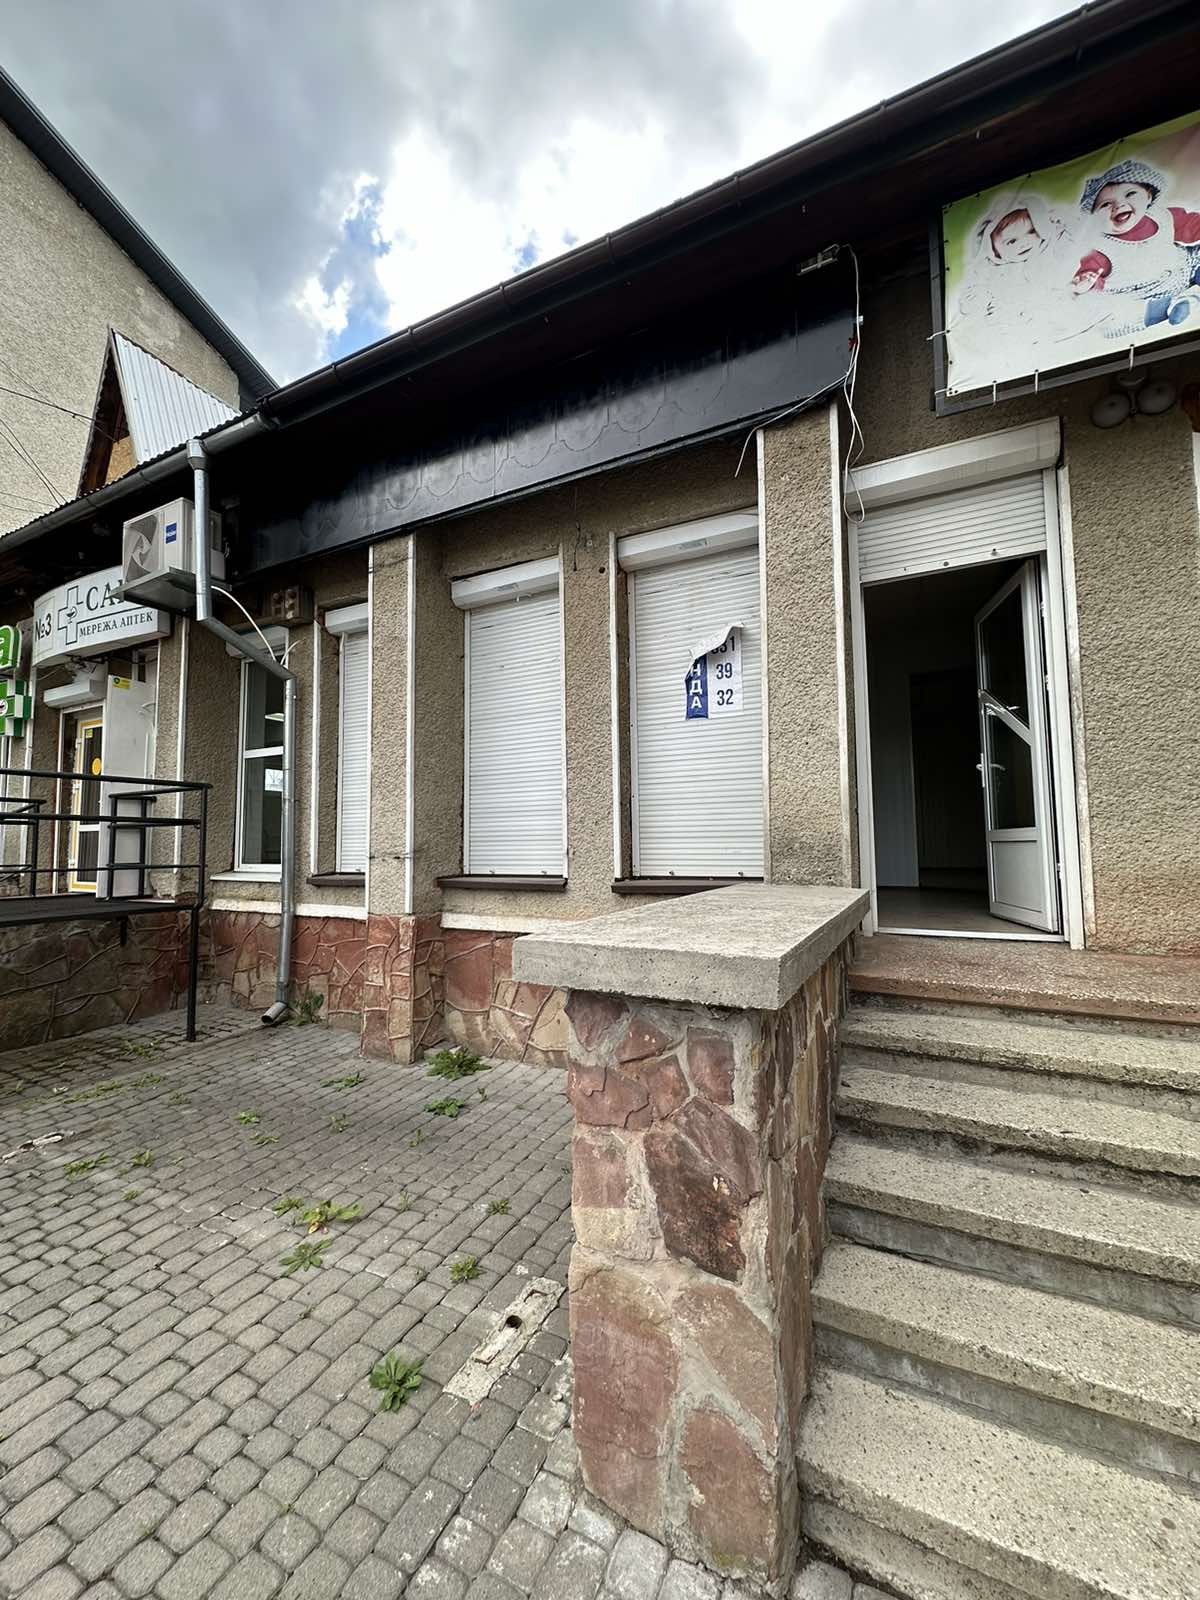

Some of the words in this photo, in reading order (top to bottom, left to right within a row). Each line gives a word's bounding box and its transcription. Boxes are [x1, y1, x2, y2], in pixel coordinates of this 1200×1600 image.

[35, 612, 52, 641] №3
[80, 618, 118, 637] МЕРЕЖА
[119, 611, 153, 628] АПТЕК
[716, 663, 733, 680] 39
[717, 689, 734, 706] 32
